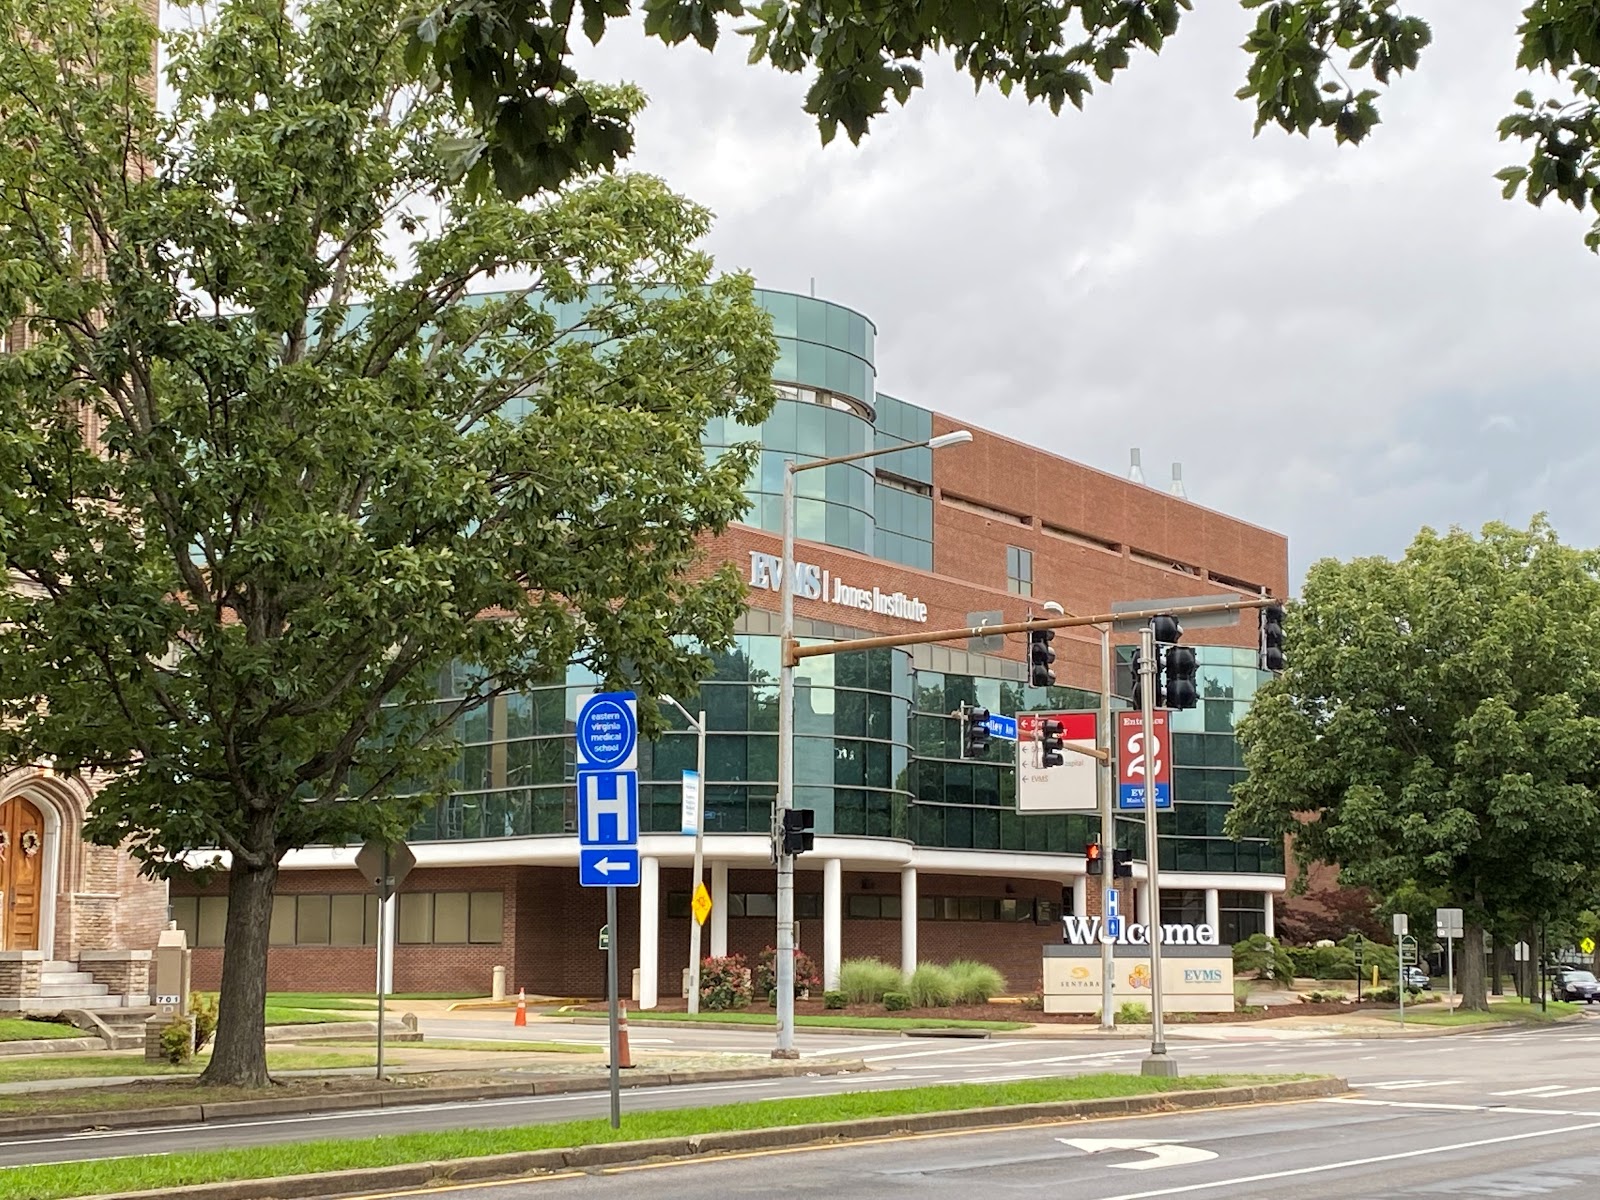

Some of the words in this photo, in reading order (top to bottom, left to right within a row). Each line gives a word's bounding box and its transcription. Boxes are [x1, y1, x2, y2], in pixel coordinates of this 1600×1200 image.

[749, 551, 821, 600] EVMS
[832, 577, 873, 611] Jones
[872, 587, 927, 623] Institute
[591, 713, 620, 721] eastern
[1123, 717, 1164, 726] Entrce
[591, 722, 621, 733] virginia
[591, 733, 622, 742] medical
[594, 744, 619, 752] school
[1127, 732, 1162, 778] 2
[586, 774, 629, 841] H
[1108, 890, 1118, 917] H
[1183, 969, 1222, 981] EVMS
